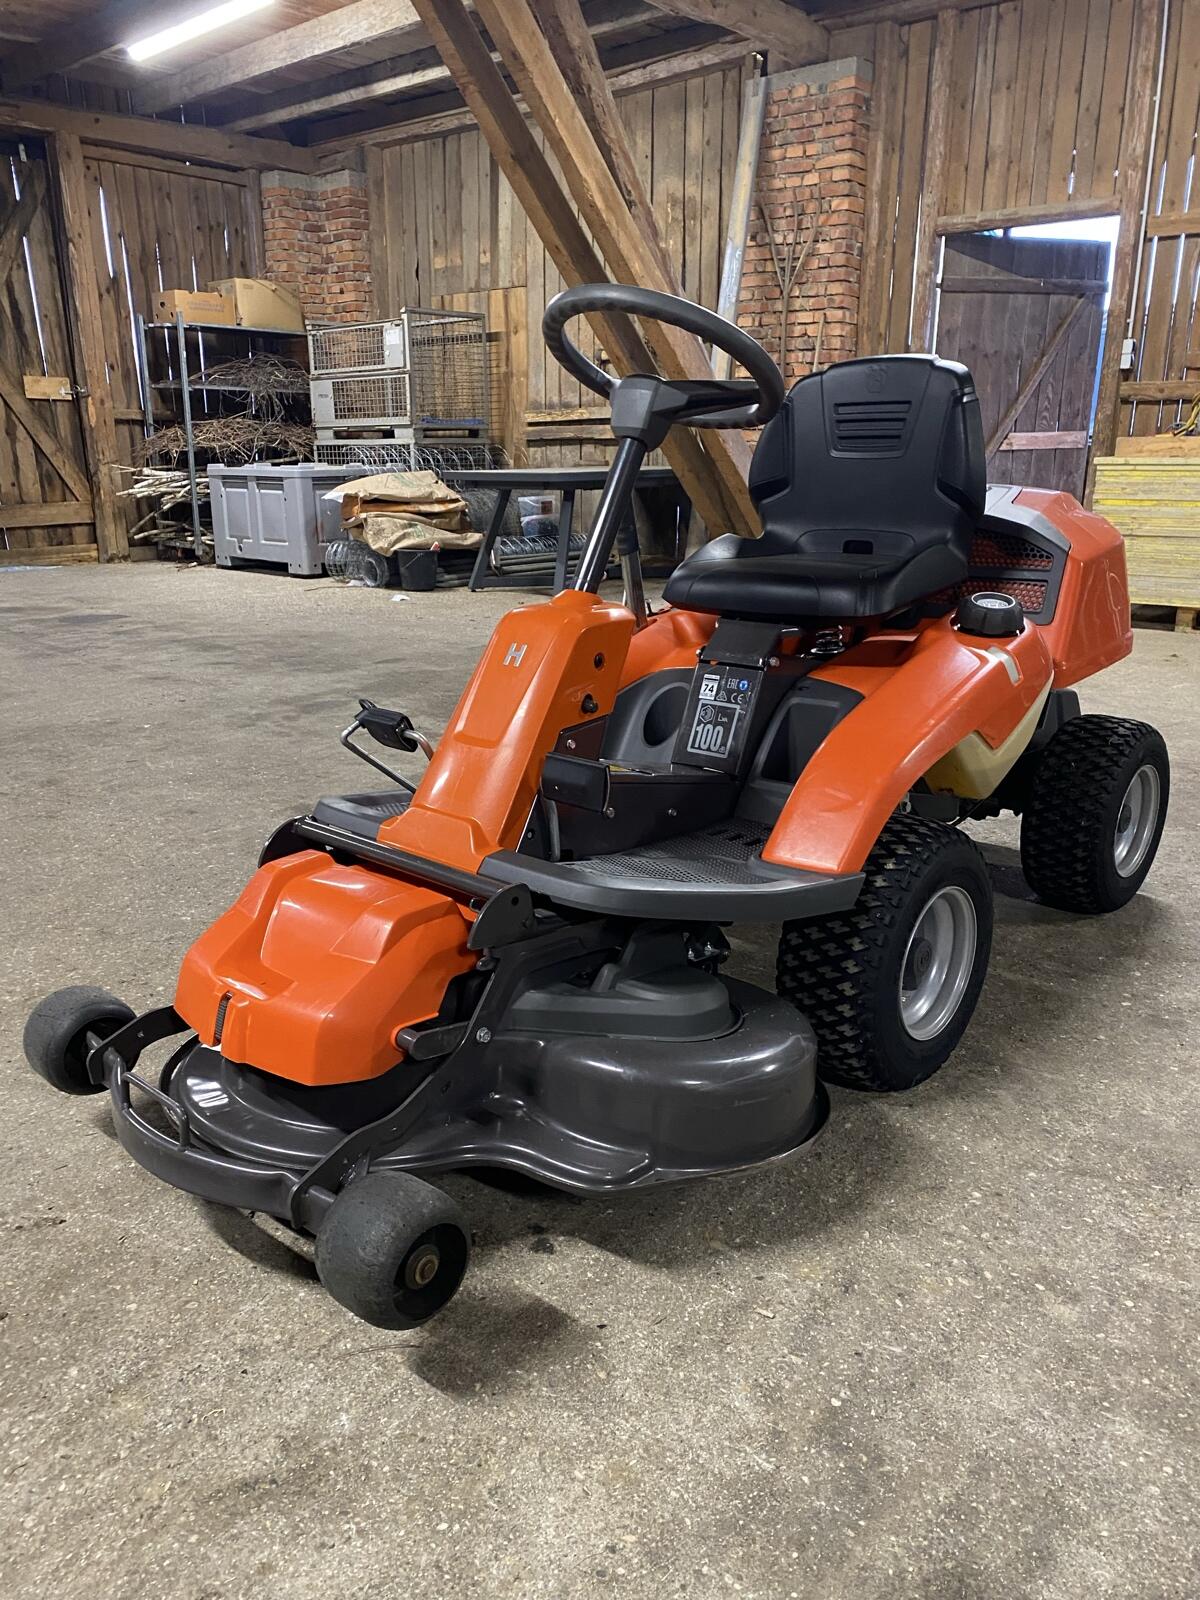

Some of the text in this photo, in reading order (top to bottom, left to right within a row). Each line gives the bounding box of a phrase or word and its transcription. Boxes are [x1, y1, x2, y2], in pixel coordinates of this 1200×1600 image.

[503, 642, 528, 667] H
[703, 684, 714, 693] 74
[731, 693, 744, 703] CE
[694, 723, 724, 752] 100
